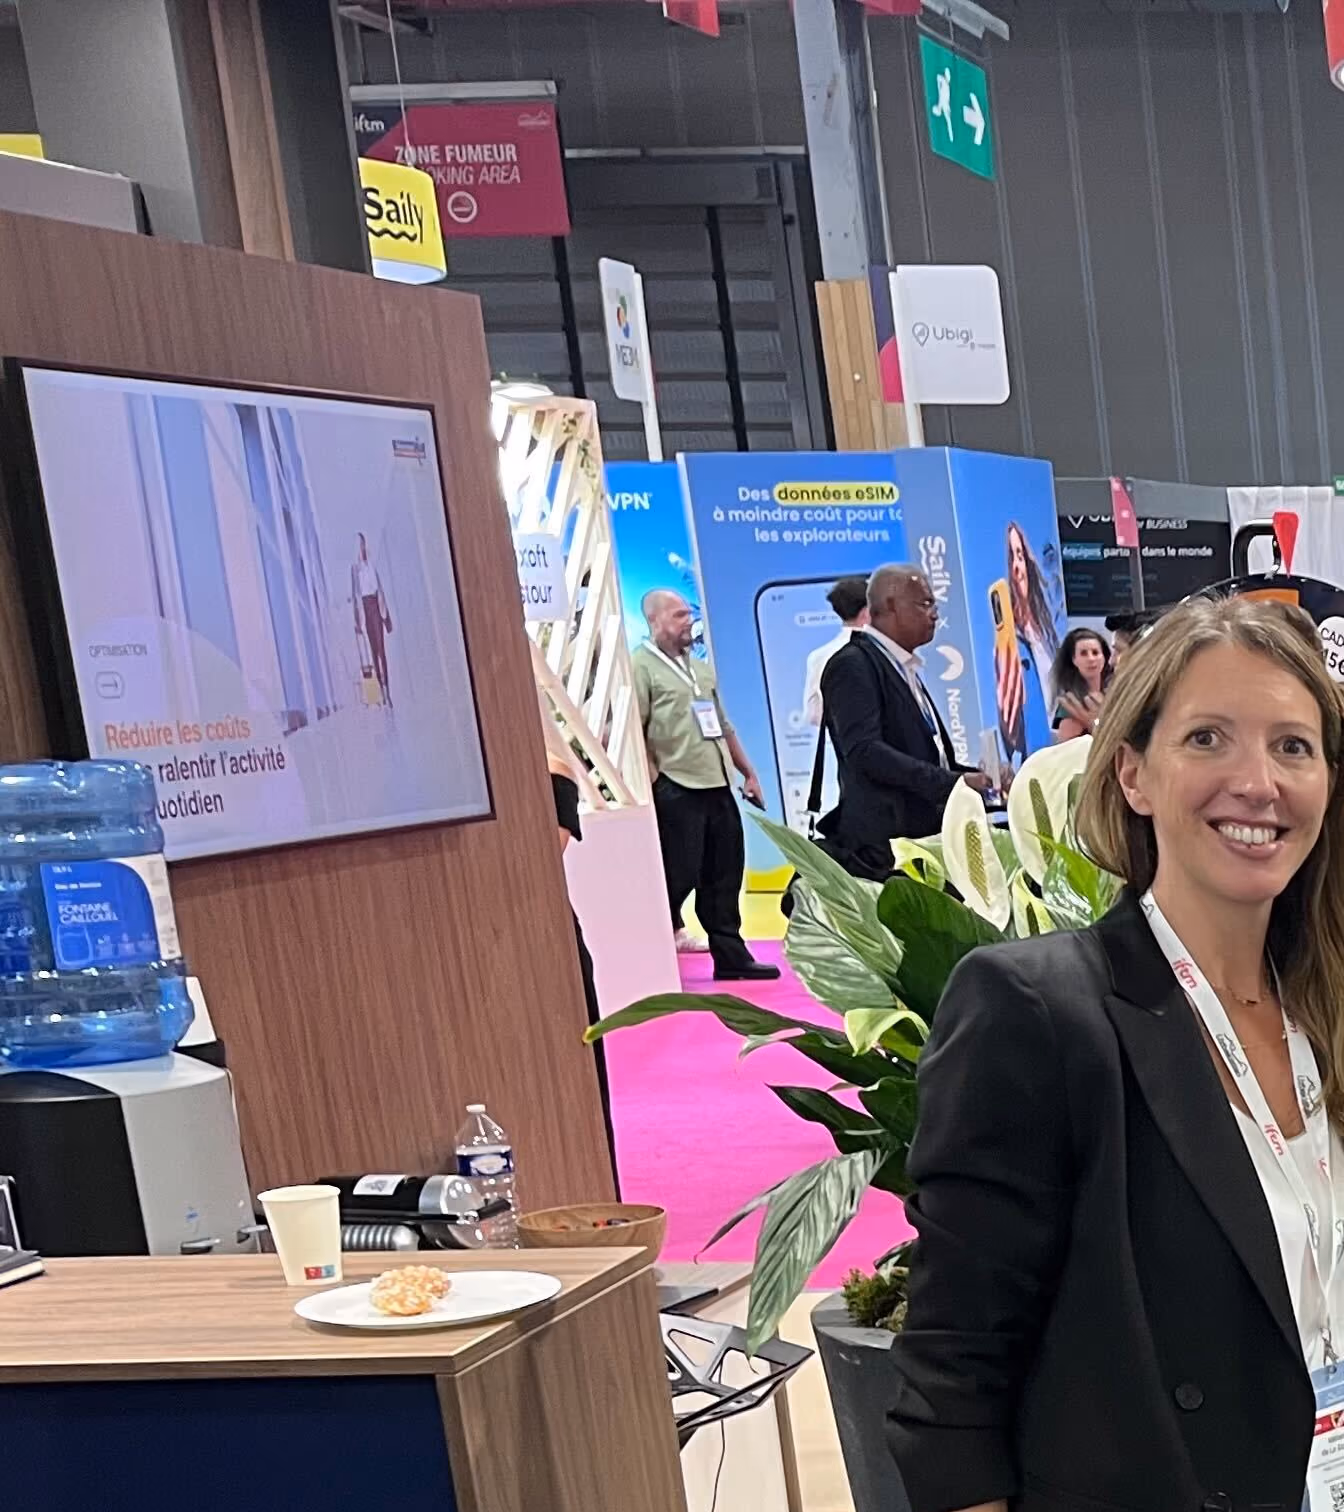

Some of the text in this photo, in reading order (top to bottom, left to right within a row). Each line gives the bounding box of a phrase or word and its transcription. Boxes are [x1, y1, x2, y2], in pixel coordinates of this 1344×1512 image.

[395, 143, 518, 165] ZONE FUMEUR
[478, 164, 521, 185] AREA
[362, 187, 423, 243] Saily
[932, 326, 973, 344] Ubigi
[738, 485, 896, 502] Des données eSIM
[713, 506, 724, 522] à
[728, 507, 800, 522] moindre
[803, 506, 842, 522] coût
[846, 509, 884, 526] pour
[754, 527, 891, 547] les explorateurs
[1141, 546, 1166, 557] dans
[1167, 546, 1176, 557] le
[1178, 546, 1213, 557] monde
[927, 536, 952, 603] Saily
[104, 715, 251, 750] Réduire les coûts
[947, 688, 969, 767] NordVPN
[159, 744, 285, 783] ralentir l'activité
[156, 790, 224, 820] uotidien
